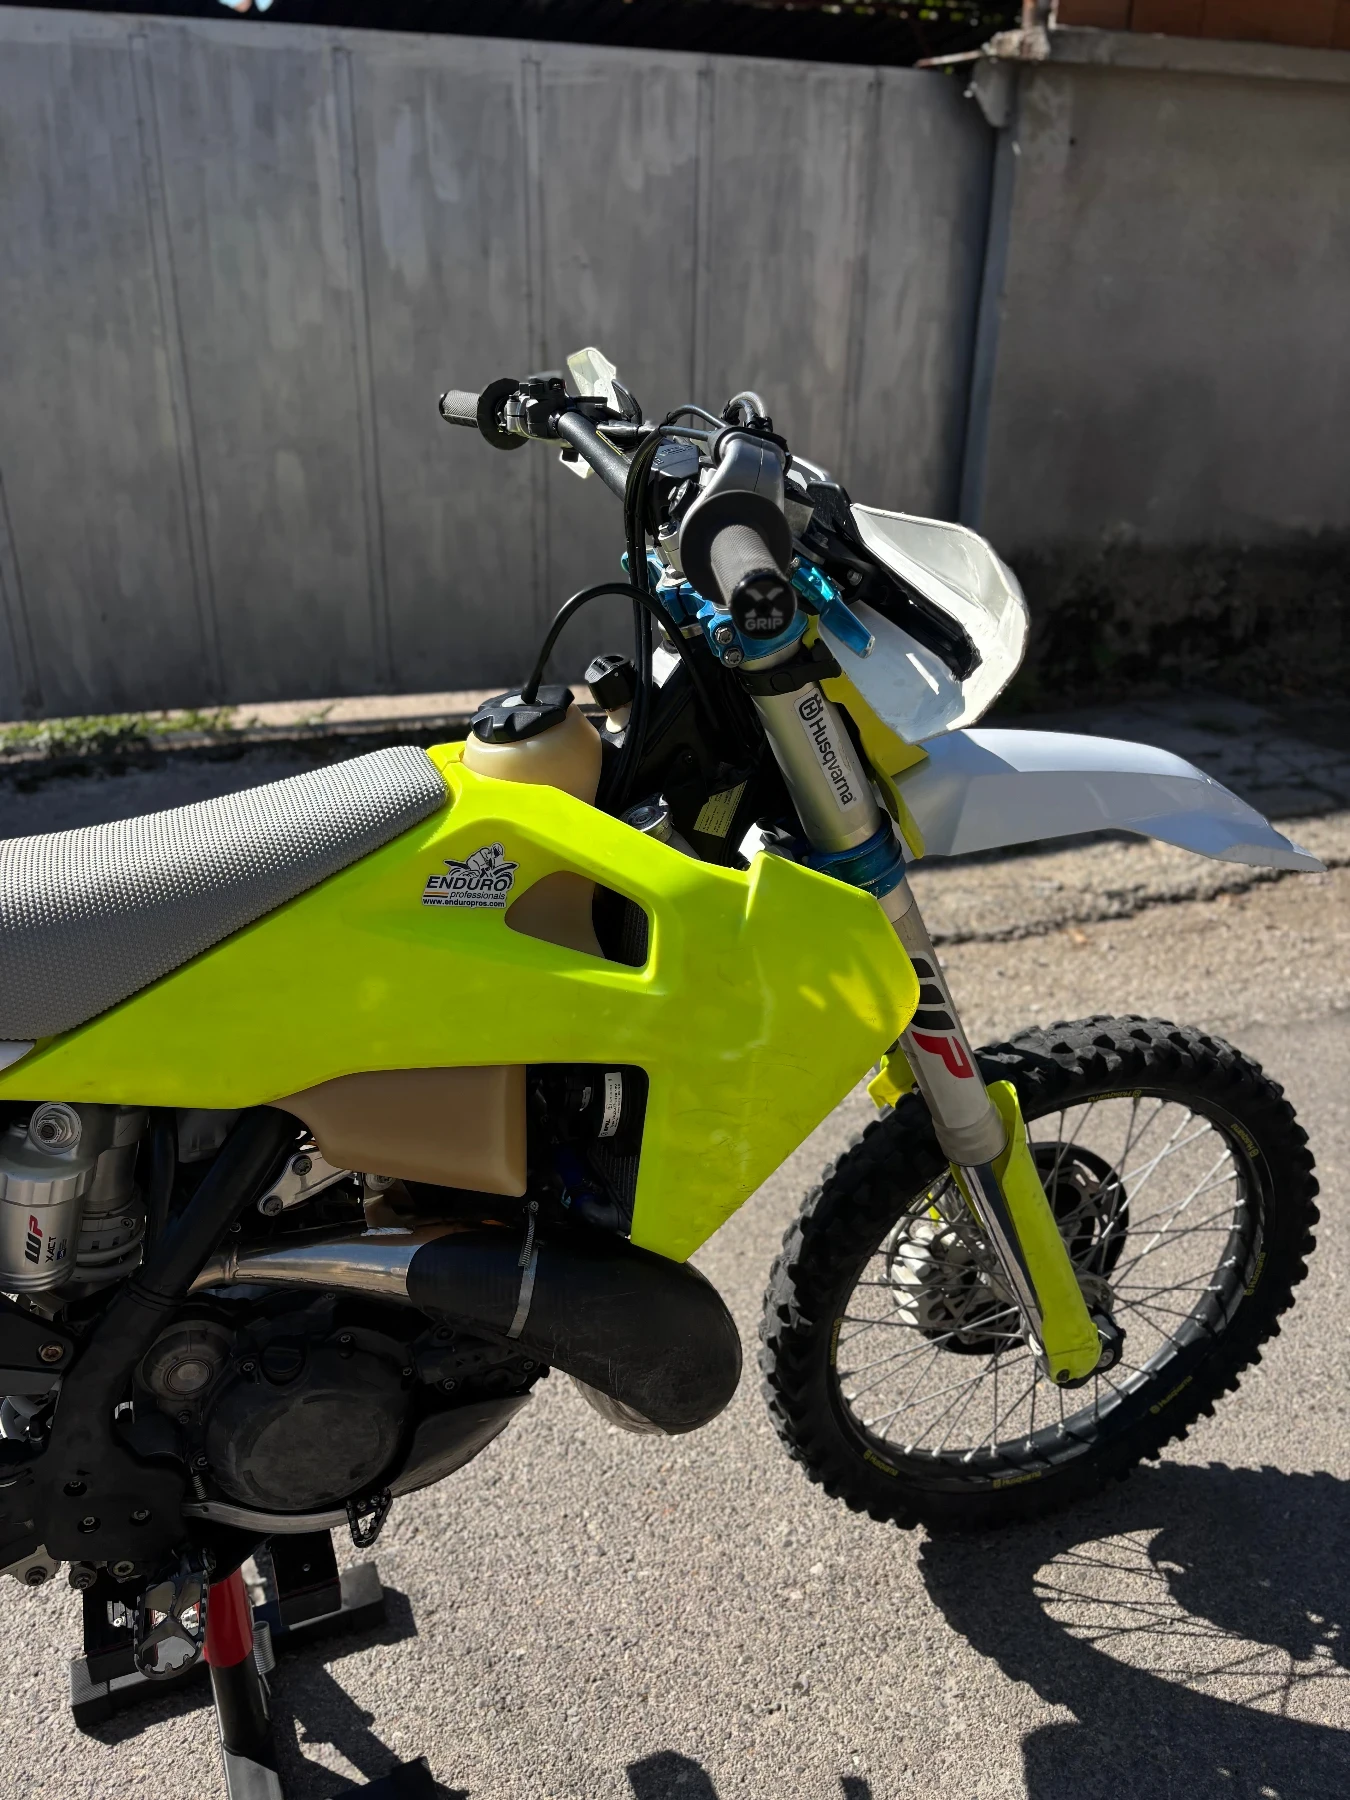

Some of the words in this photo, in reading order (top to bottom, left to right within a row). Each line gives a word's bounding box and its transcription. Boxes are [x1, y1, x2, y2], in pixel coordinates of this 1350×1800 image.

[744, 617, 784, 631] GRIP
[809, 716, 854, 806] Husqvarna
[427, 876, 507, 891] ENDURO
[450, 891, 505, 900] professionals
[423, 898, 505, 908] www.enduropros.com
[45, 1236, 57, 1263] XACT
